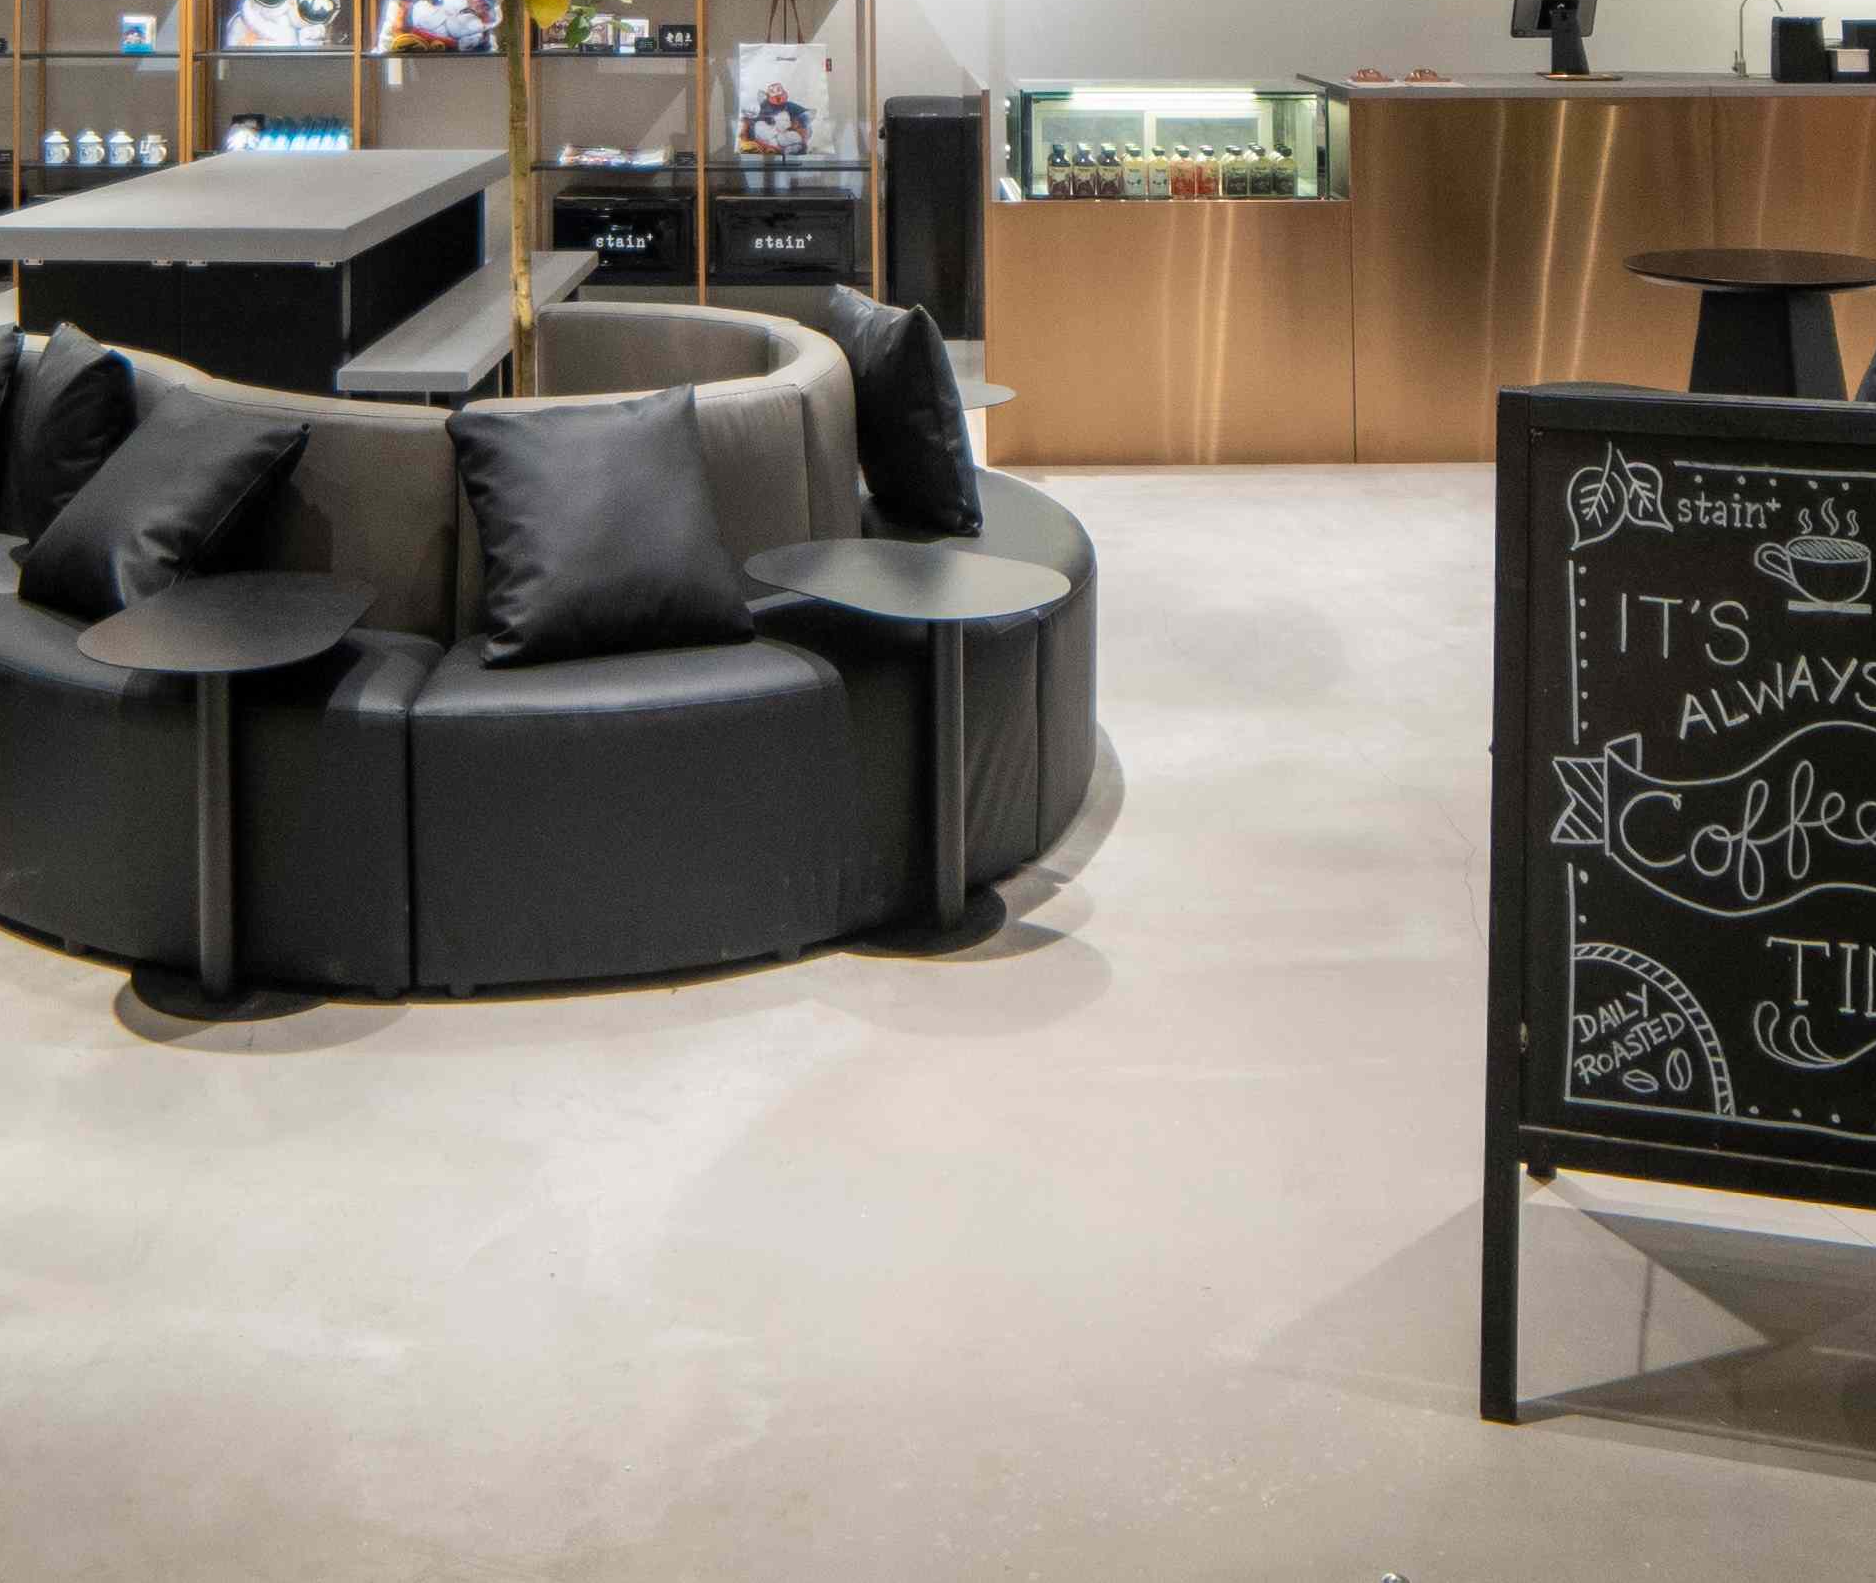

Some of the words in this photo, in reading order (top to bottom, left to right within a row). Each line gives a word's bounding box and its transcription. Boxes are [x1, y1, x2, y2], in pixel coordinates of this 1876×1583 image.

[1619, 591, 1750, 666] IT'S
[1573, 1012, 1686, 1085] ROASTED
[1574, 983, 1649, 1043] DAILY
